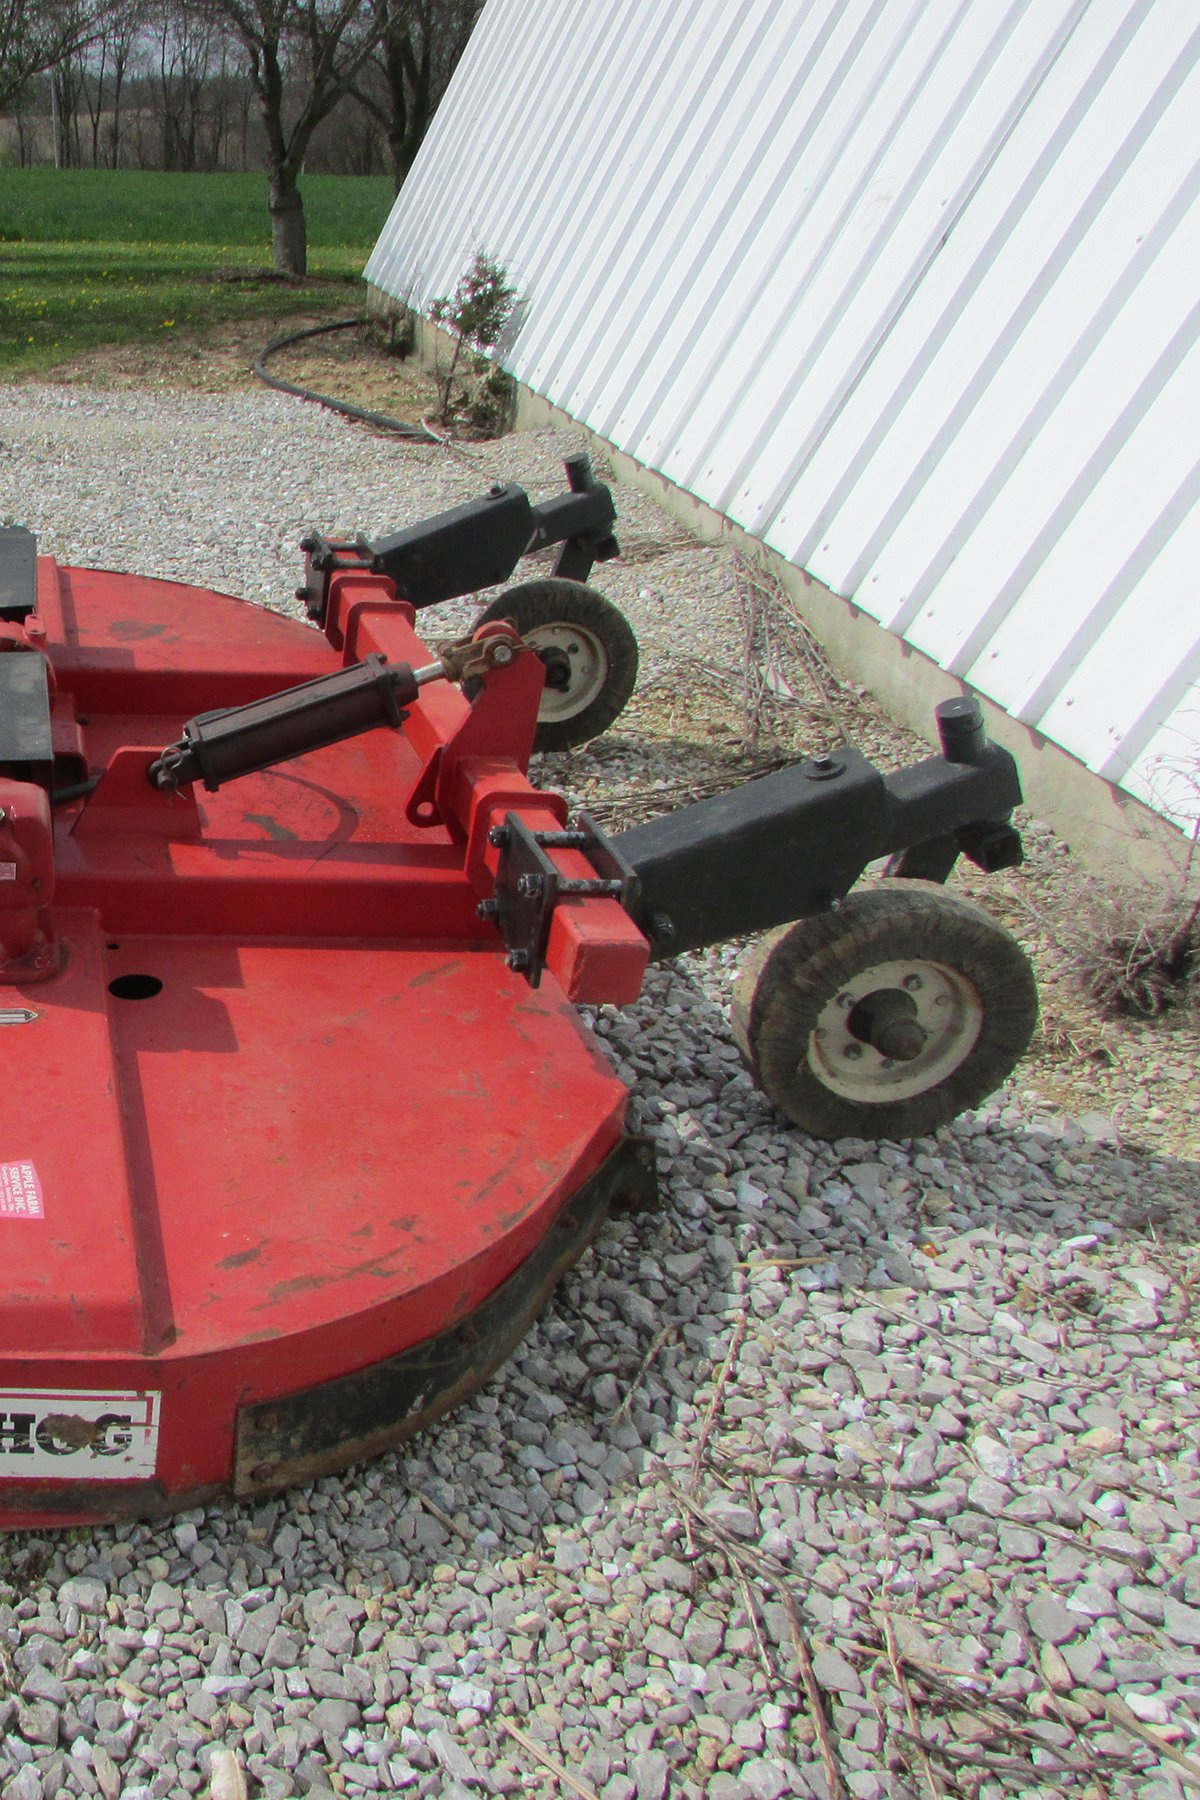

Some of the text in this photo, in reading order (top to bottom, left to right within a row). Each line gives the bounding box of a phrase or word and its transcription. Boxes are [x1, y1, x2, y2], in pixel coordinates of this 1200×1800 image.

[9, 1166, 26, 1213] SERVICE INC.
[20, 1164, 40, 1214] APPLE FARM
